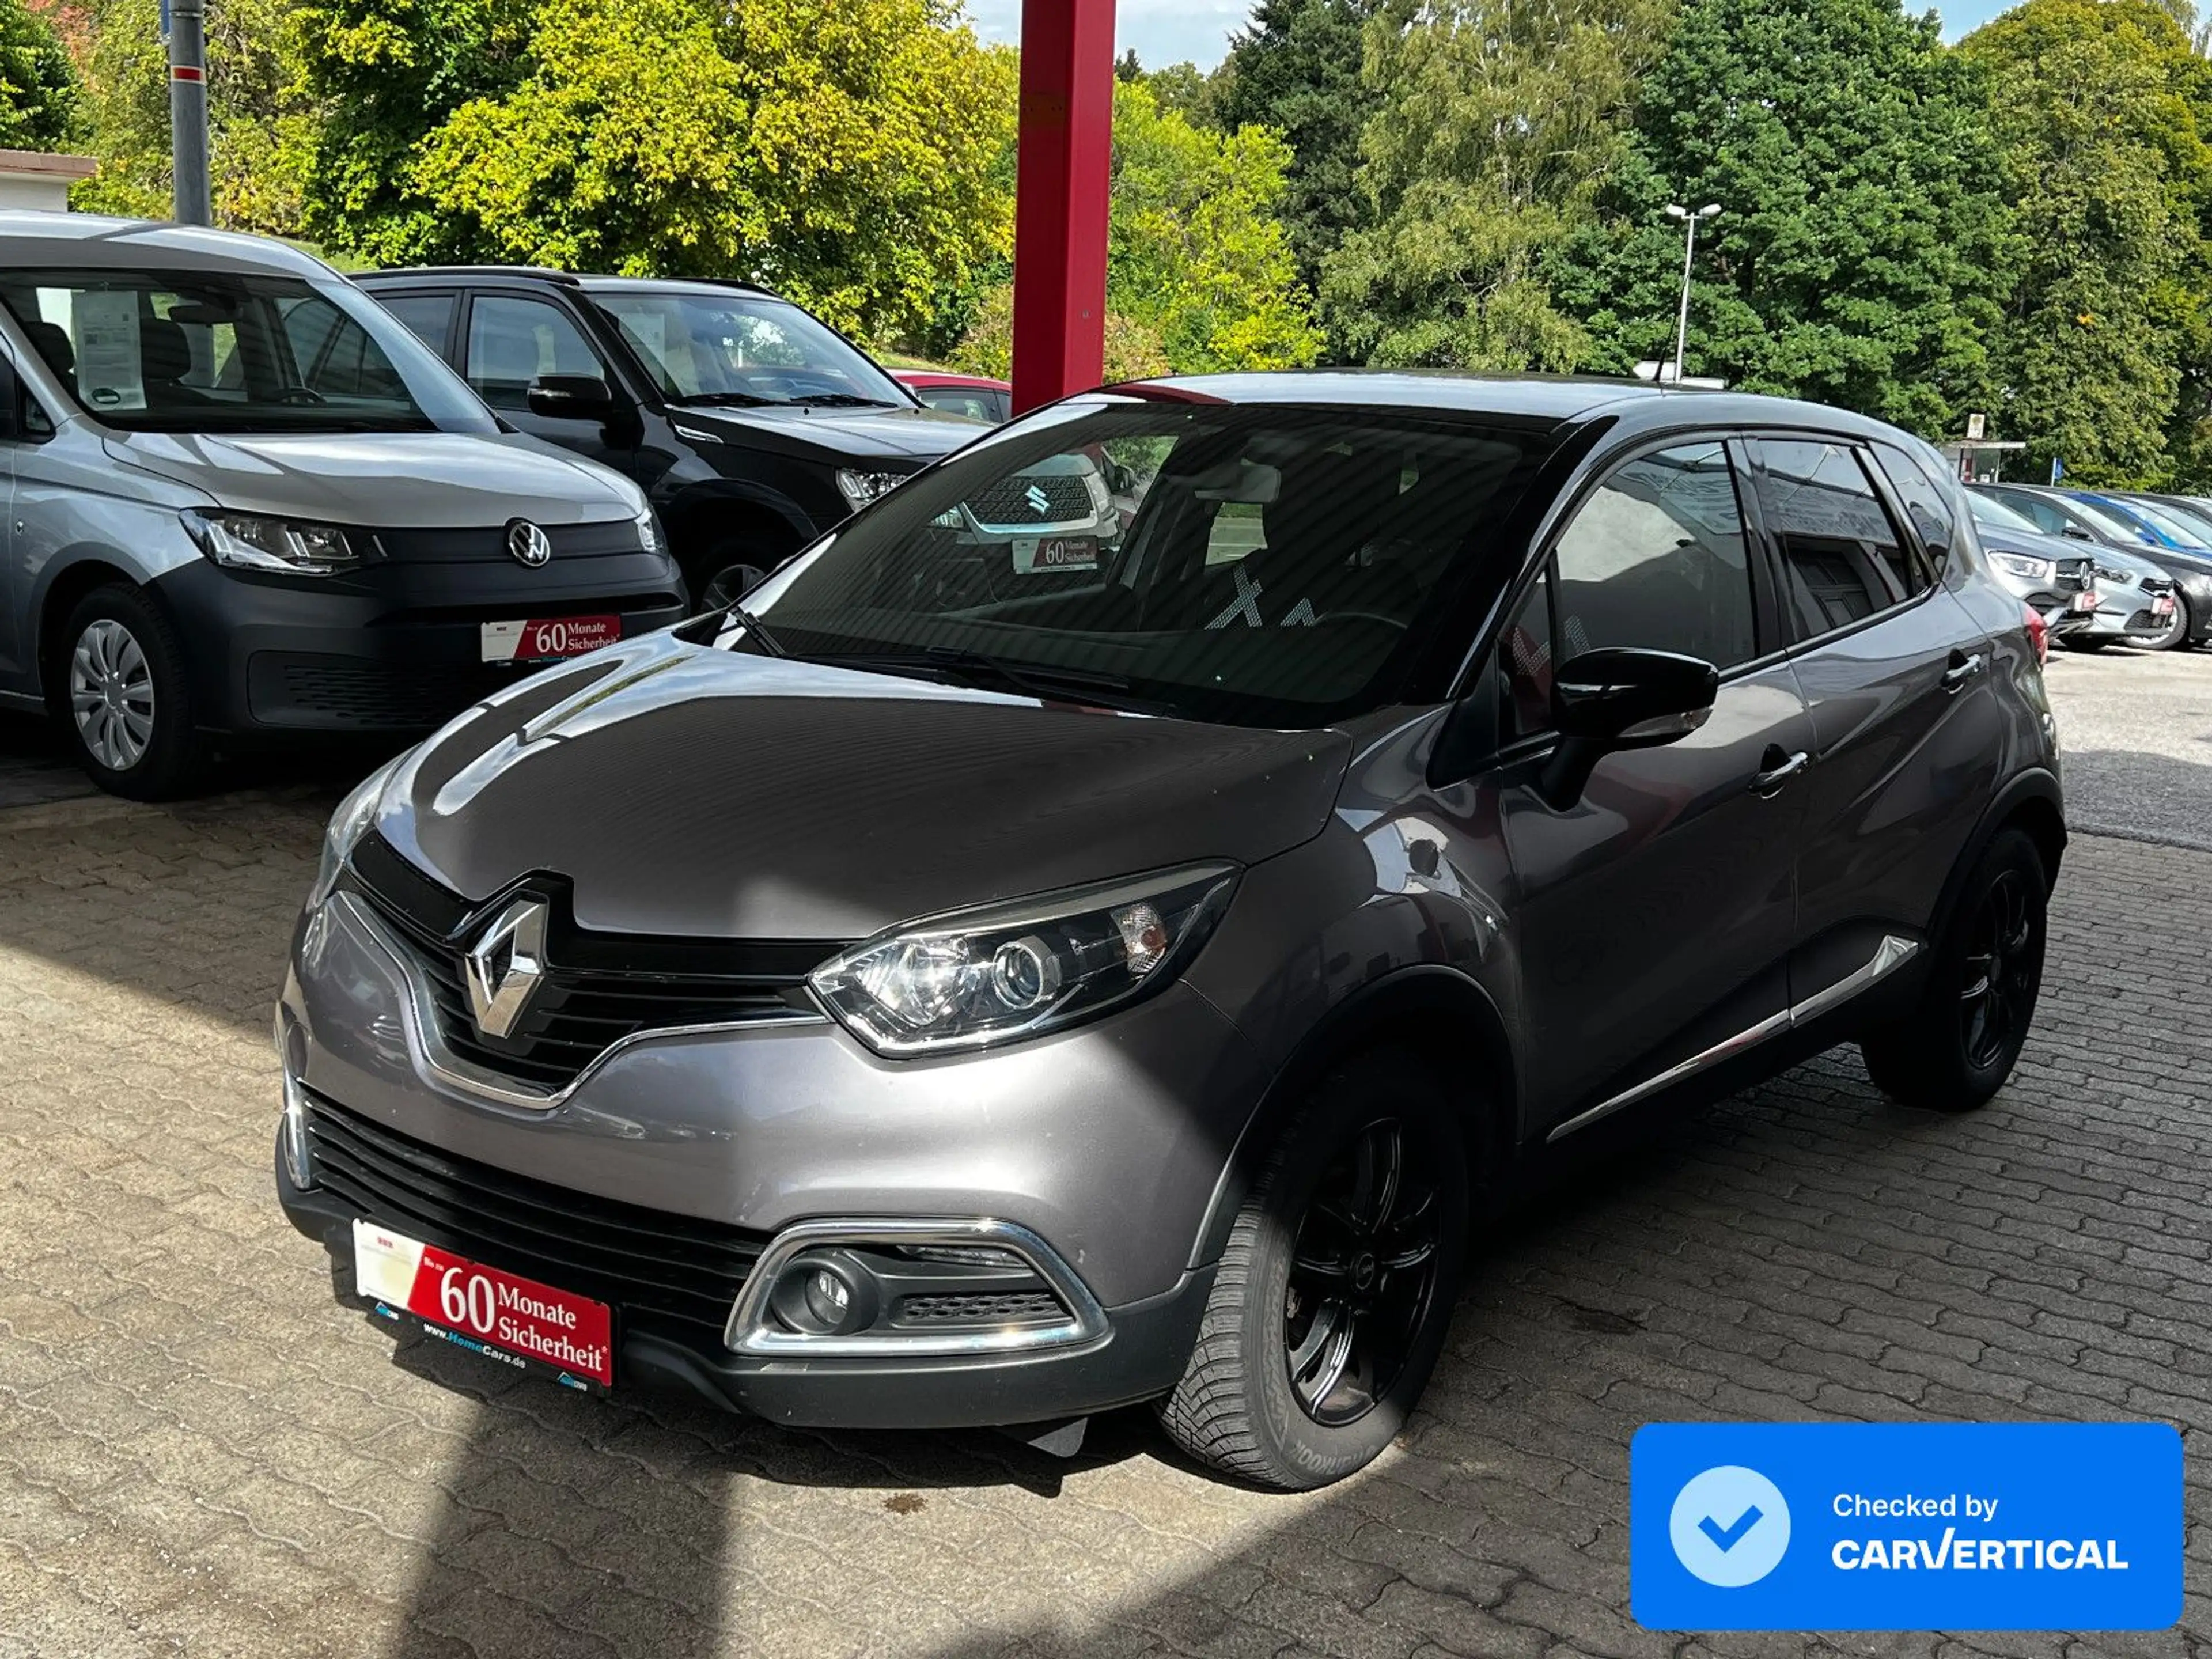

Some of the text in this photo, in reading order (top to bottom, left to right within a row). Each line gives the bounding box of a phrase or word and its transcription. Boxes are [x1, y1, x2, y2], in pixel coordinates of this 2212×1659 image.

[1046, 541, 1064, 563] 60
[536, 623, 566, 653] 60
[567, 622, 606, 634] Monate
[441, 1267, 495, 1333] 60
[497, 1282, 576, 1330] Monate
[423, 1323, 527, 1369] www.HomeCars.de
